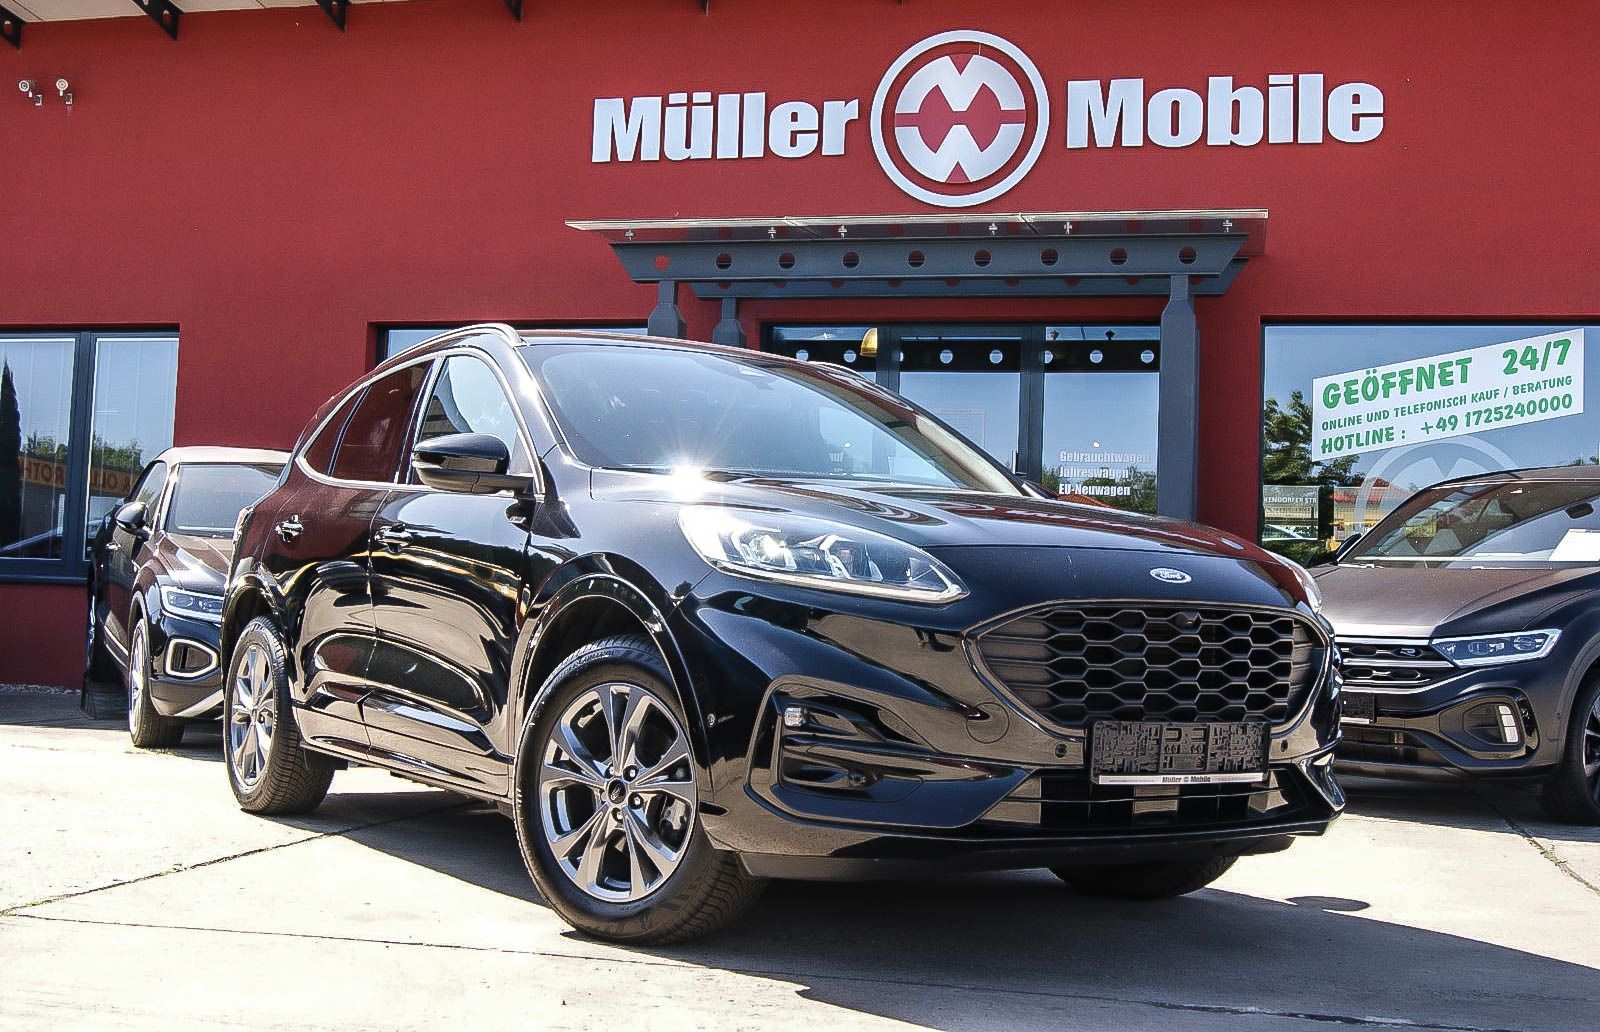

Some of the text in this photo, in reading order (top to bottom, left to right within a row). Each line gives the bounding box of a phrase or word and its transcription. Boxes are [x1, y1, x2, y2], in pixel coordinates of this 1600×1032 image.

[591, 73, 1384, 163] Müller Mobile
[1321, 414, 1363, 431] ONLINE
[1366, 409, 1390, 423] UND
[1394, 394, 1467, 418] TELEFONISCH
[1471, 388, 1500, 404] KAUF
[1512, 375, 1573, 396] BERATUNG
[1322, 338, 1572, 410] GEÖFFNET 24/7
[1320, 425, 1395, 454] HOTLINE
[1420, 414, 1459, 435] +49
[1464, 393, 1573, 428] 1725240000
[1058, 483, 1131, 497] EU-Neuwagen
